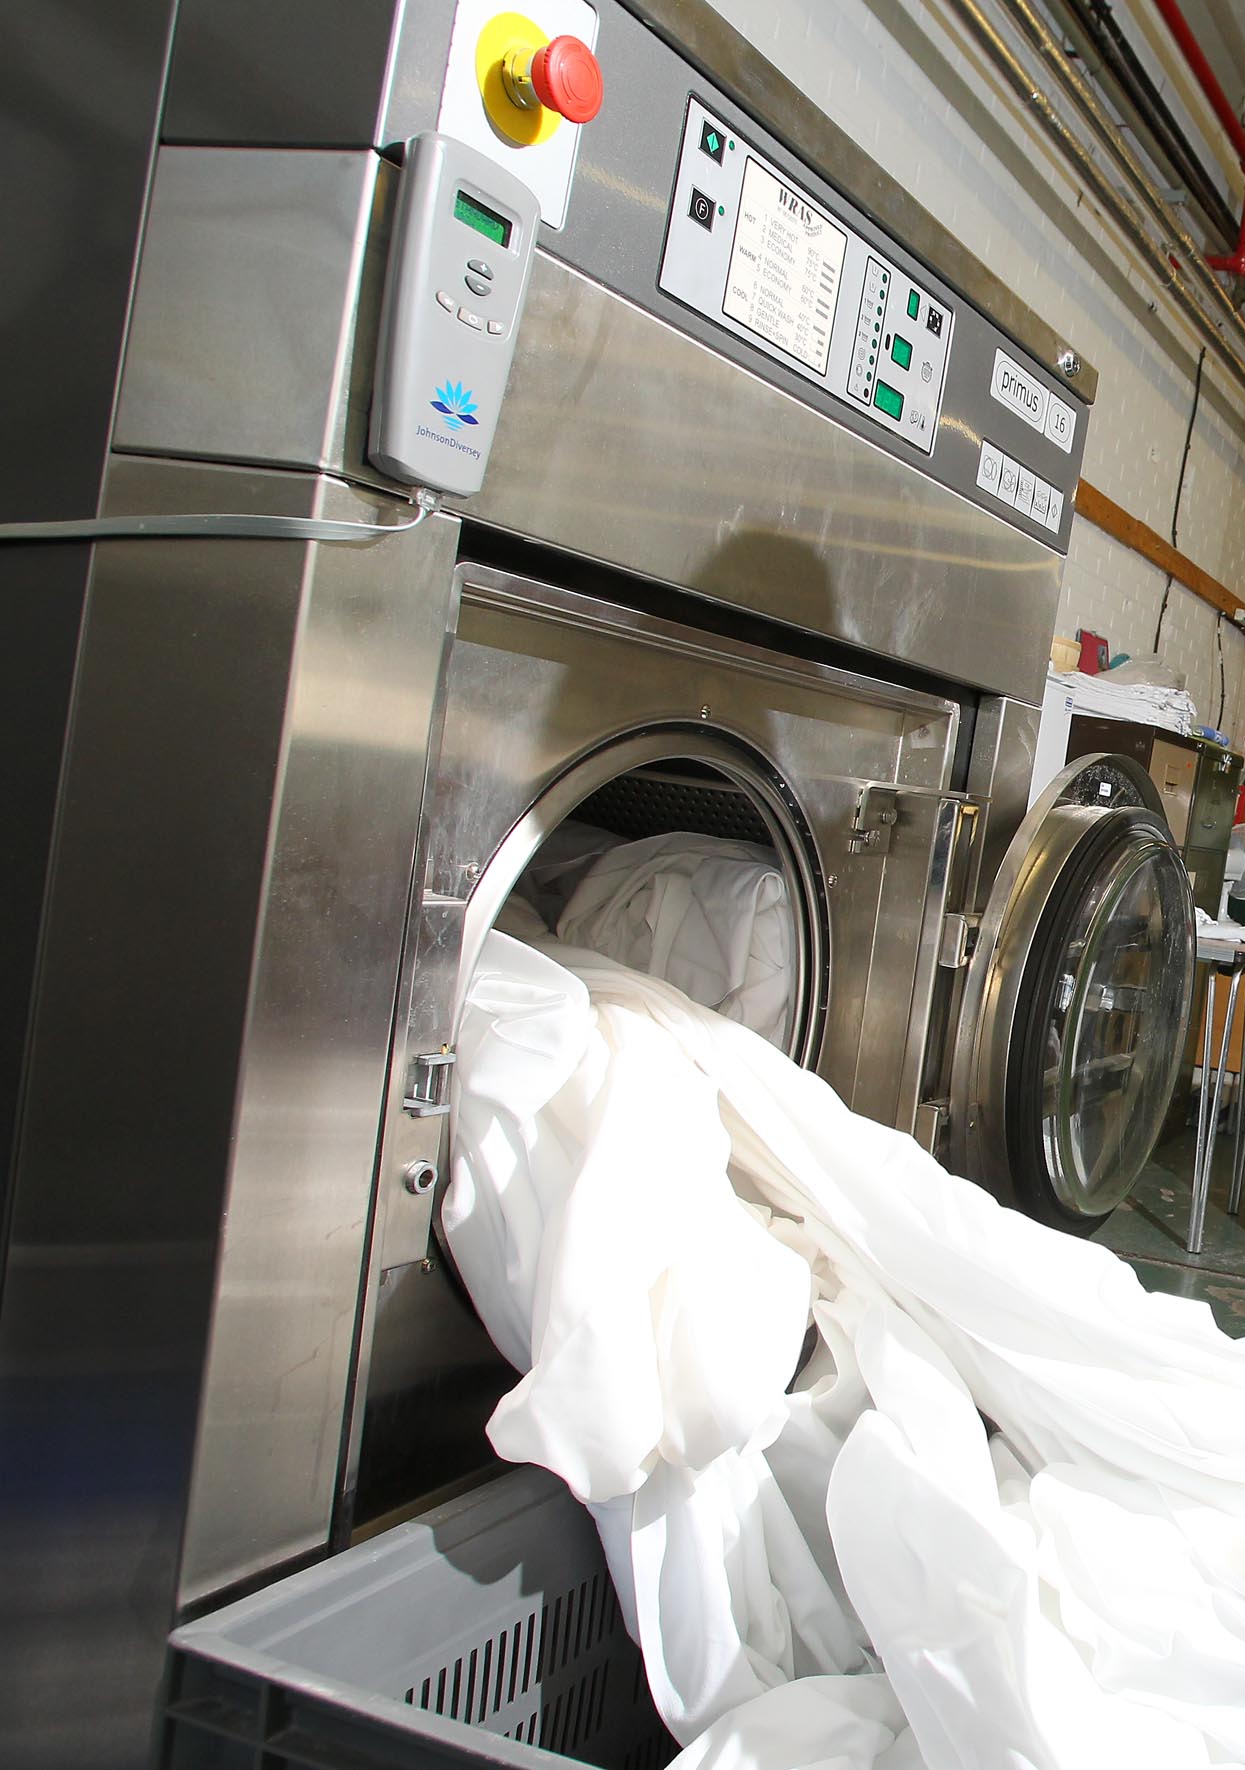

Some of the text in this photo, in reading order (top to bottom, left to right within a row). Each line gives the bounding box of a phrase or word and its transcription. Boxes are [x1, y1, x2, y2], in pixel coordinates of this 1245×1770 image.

[699, 203, 706, 215] F
[744, 211, 756, 225] HOT
[779, 189, 812, 225] WRAS
[768, 229, 793, 253] MEDICAL
[770, 217, 785, 235] VERY
[786, 230, 799, 245] HOT
[739, 245, 756, 263] WARM
[767, 240, 795, 266] ECONOMY
[764, 257, 788, 280] NORMAL
[762, 268, 791, 294] ECONOMY
[732, 286, 748, 301] COOL
[760, 285, 784, 308] NORMAL
[756, 307, 779, 328] GENTLE
[758, 296, 776, 314] QUICK
[777, 309, 794, 326] WASH
[792, 344, 807, 359] COLD
[1001, 371, 1039, 413] primus
[1055, 413, 1065, 434] 16
[416, 424, 481, 460] JohnsonDiversey
